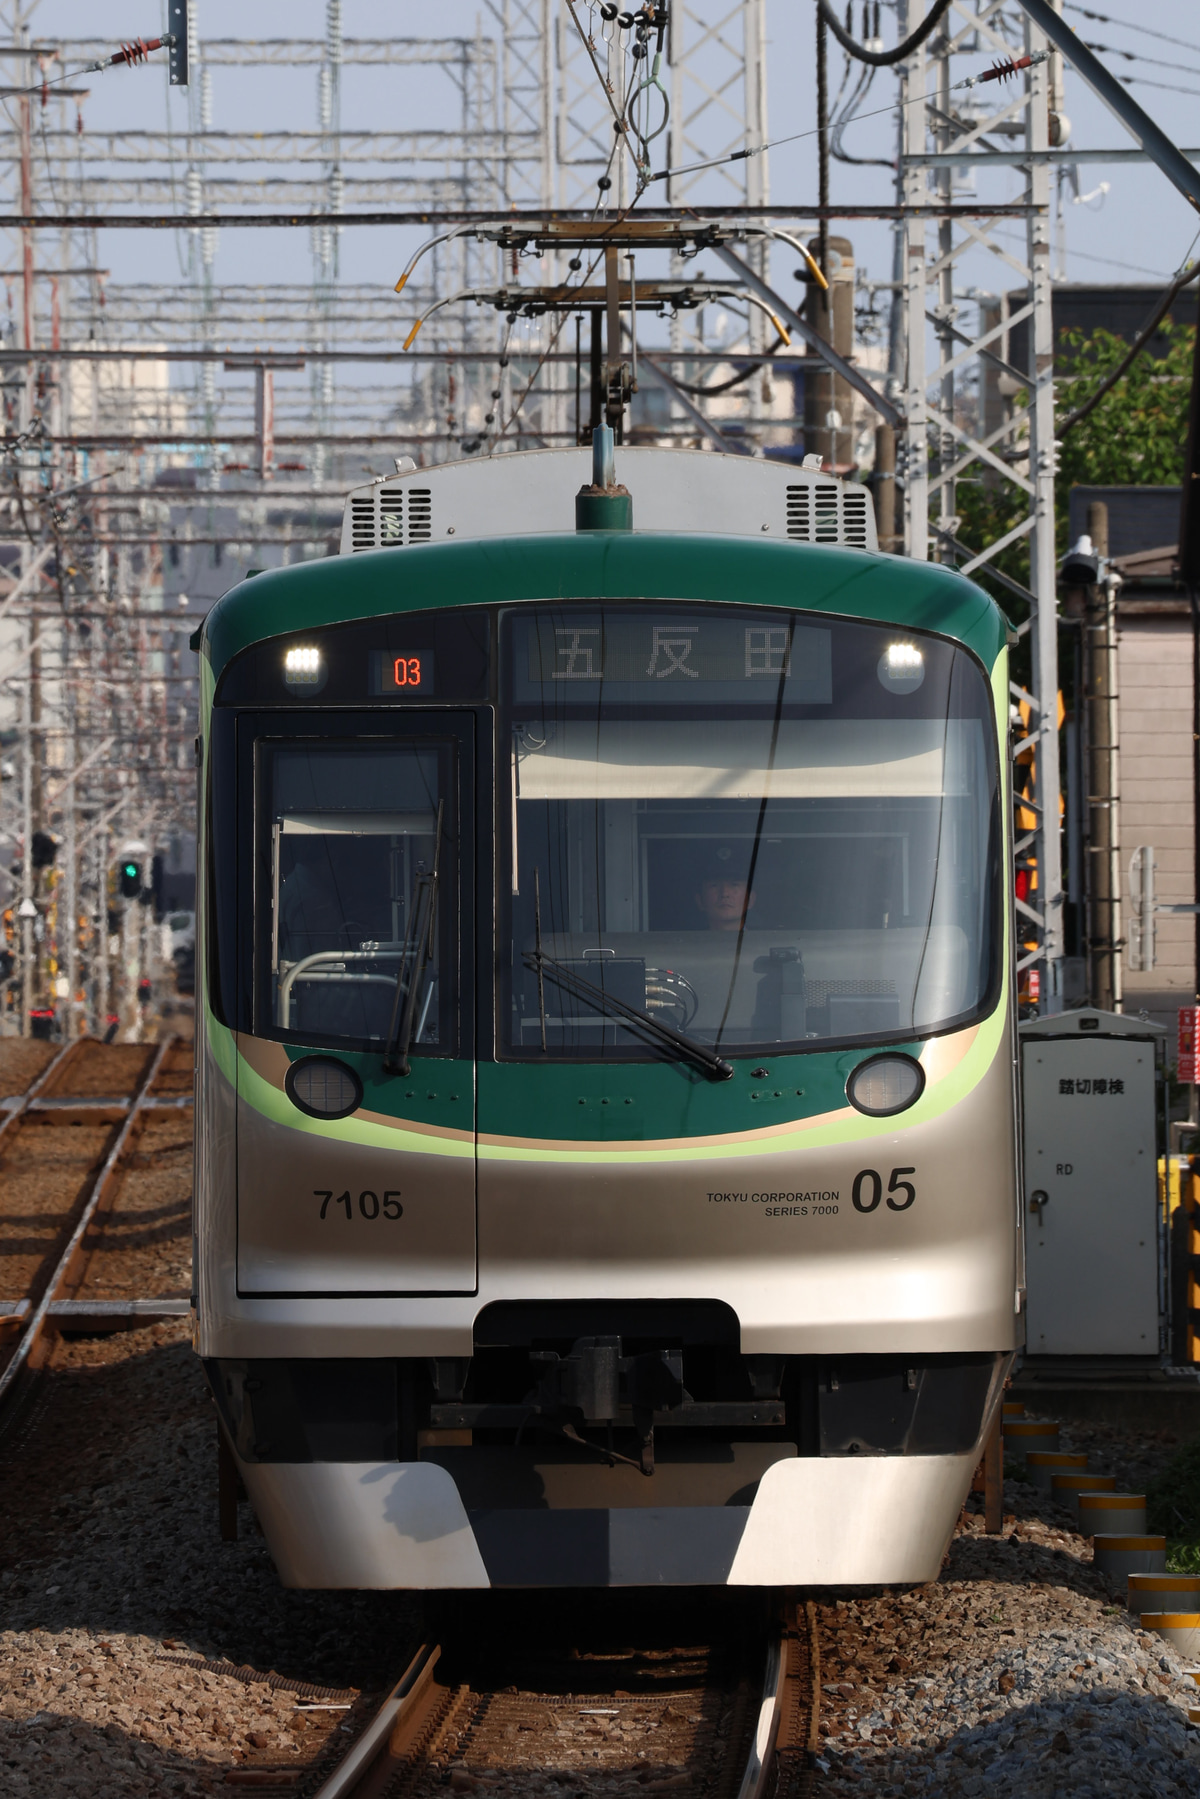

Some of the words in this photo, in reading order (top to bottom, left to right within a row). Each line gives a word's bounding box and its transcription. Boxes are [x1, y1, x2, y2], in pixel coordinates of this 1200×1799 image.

[551, 626, 792, 678] 五反田
[394, 657, 421, 686] 03
[1059, 1079, 1125, 1095] 踏切障検
[1056, 1164, 1073, 1175] RD
[707, 1192, 748, 1202] TOKYU
[752, 1191, 840, 1203] CORPORATION
[852, 1167, 916, 1213] 05
[313, 1190, 404, 1220] 7105
[765, 1206, 808, 1217] SERIES
[812, 1205, 839, 1216] 7000
